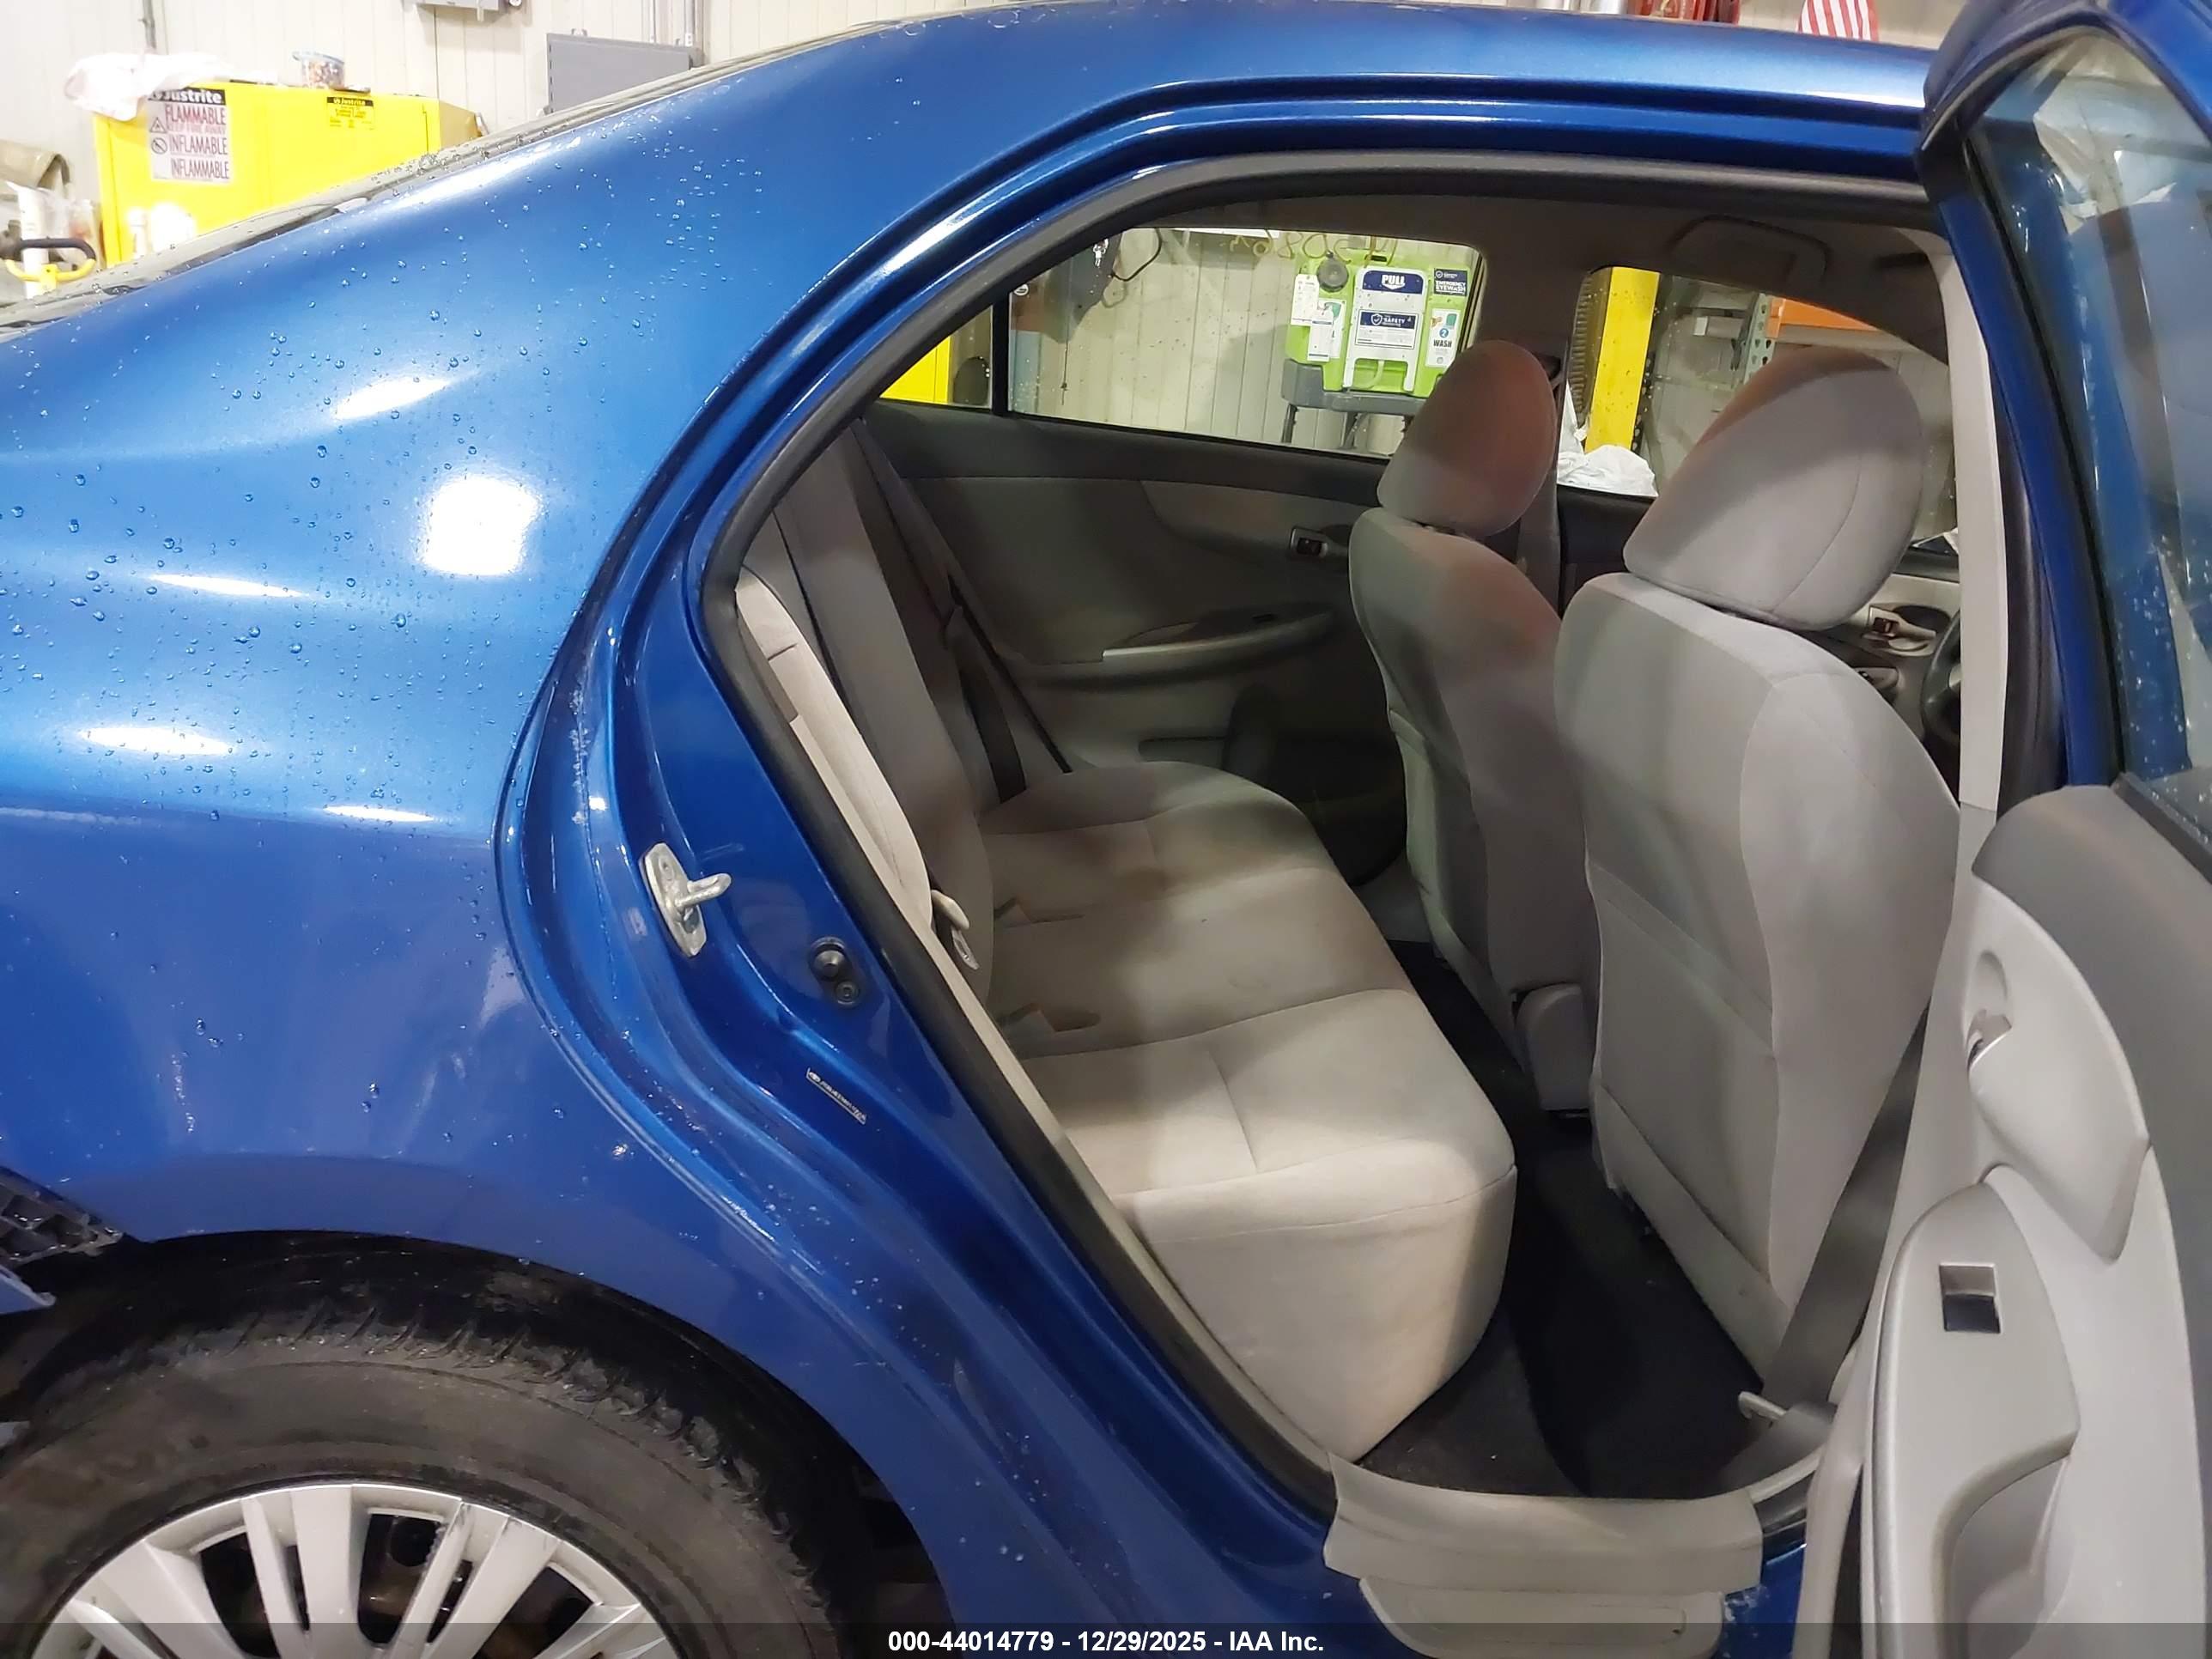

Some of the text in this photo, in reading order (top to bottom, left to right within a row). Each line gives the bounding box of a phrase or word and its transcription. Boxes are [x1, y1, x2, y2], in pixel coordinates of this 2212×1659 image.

[165, 104, 227, 125] FLAMMABLE
[169, 134, 228, 155] INFLAMABLE
[171, 158, 230, 179] INFLAMMABLE
[1381, 274, 1406, 285] PULL
[1433, 339, 1452, 348] WASH
